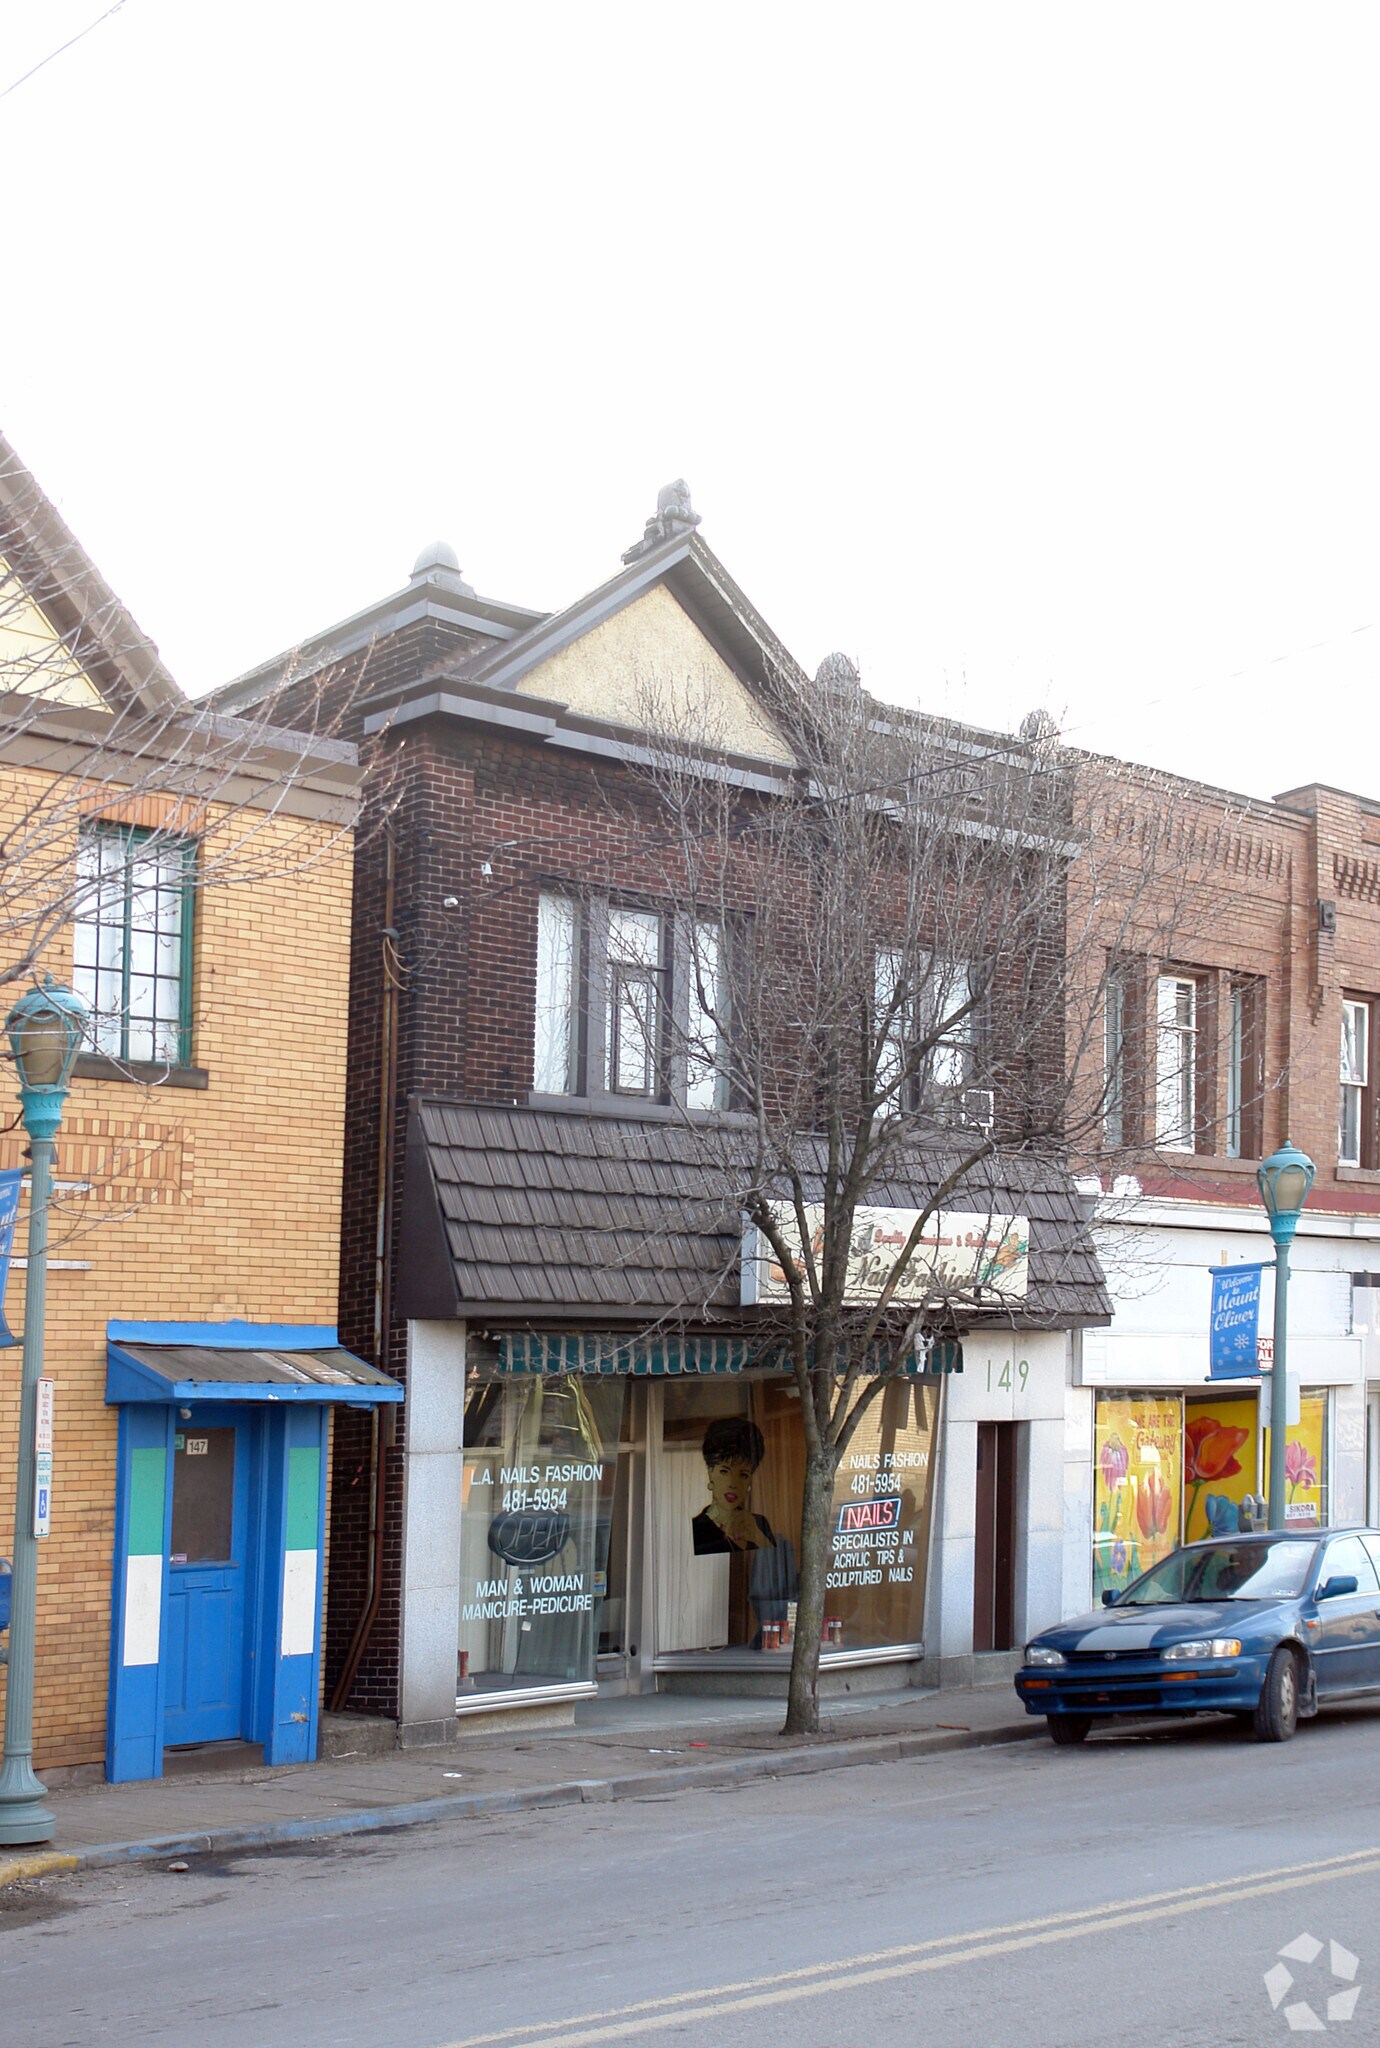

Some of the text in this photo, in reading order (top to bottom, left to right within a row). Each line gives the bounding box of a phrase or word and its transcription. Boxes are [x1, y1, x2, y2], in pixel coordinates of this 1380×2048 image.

[852, 1255, 889, 1287] Nai
[1221, 1274, 1254, 1290] Welcome
[1212, 1286, 1259, 1314] Mount
[1214, 1308, 1255, 1331] Oliver
[1257, 1349, 1274, 1361] AL
[987, 1359, 1030, 1392] 149
[189, 1441, 206, 1453] 147
[850, 1453, 880, 1469] NAILS
[883, 1452, 928, 1468] FASHION
[470, 1464, 603, 1486] L.A. NAILS FASHION
[851, 1473, 901, 1494] 481-5954
[502, 1487, 567, 1512] 481-5954
[847, 1500, 893, 1529] NAILS
[498, 1517, 568, 1550] OPEN
[832, 1530, 914, 1551] SPECIALISTS IN
[833, 1548, 904, 1569] ACRYLIC TIPS &
[476, 1580, 508, 1598] MAN
[513, 1578, 523, 1595] &
[530, 1574, 583, 1594] WOMAN
[826, 1567, 914, 1588] SCULPTURED NAILS
[462, 1594, 592, 1621] MANICURE-PEDICURE
